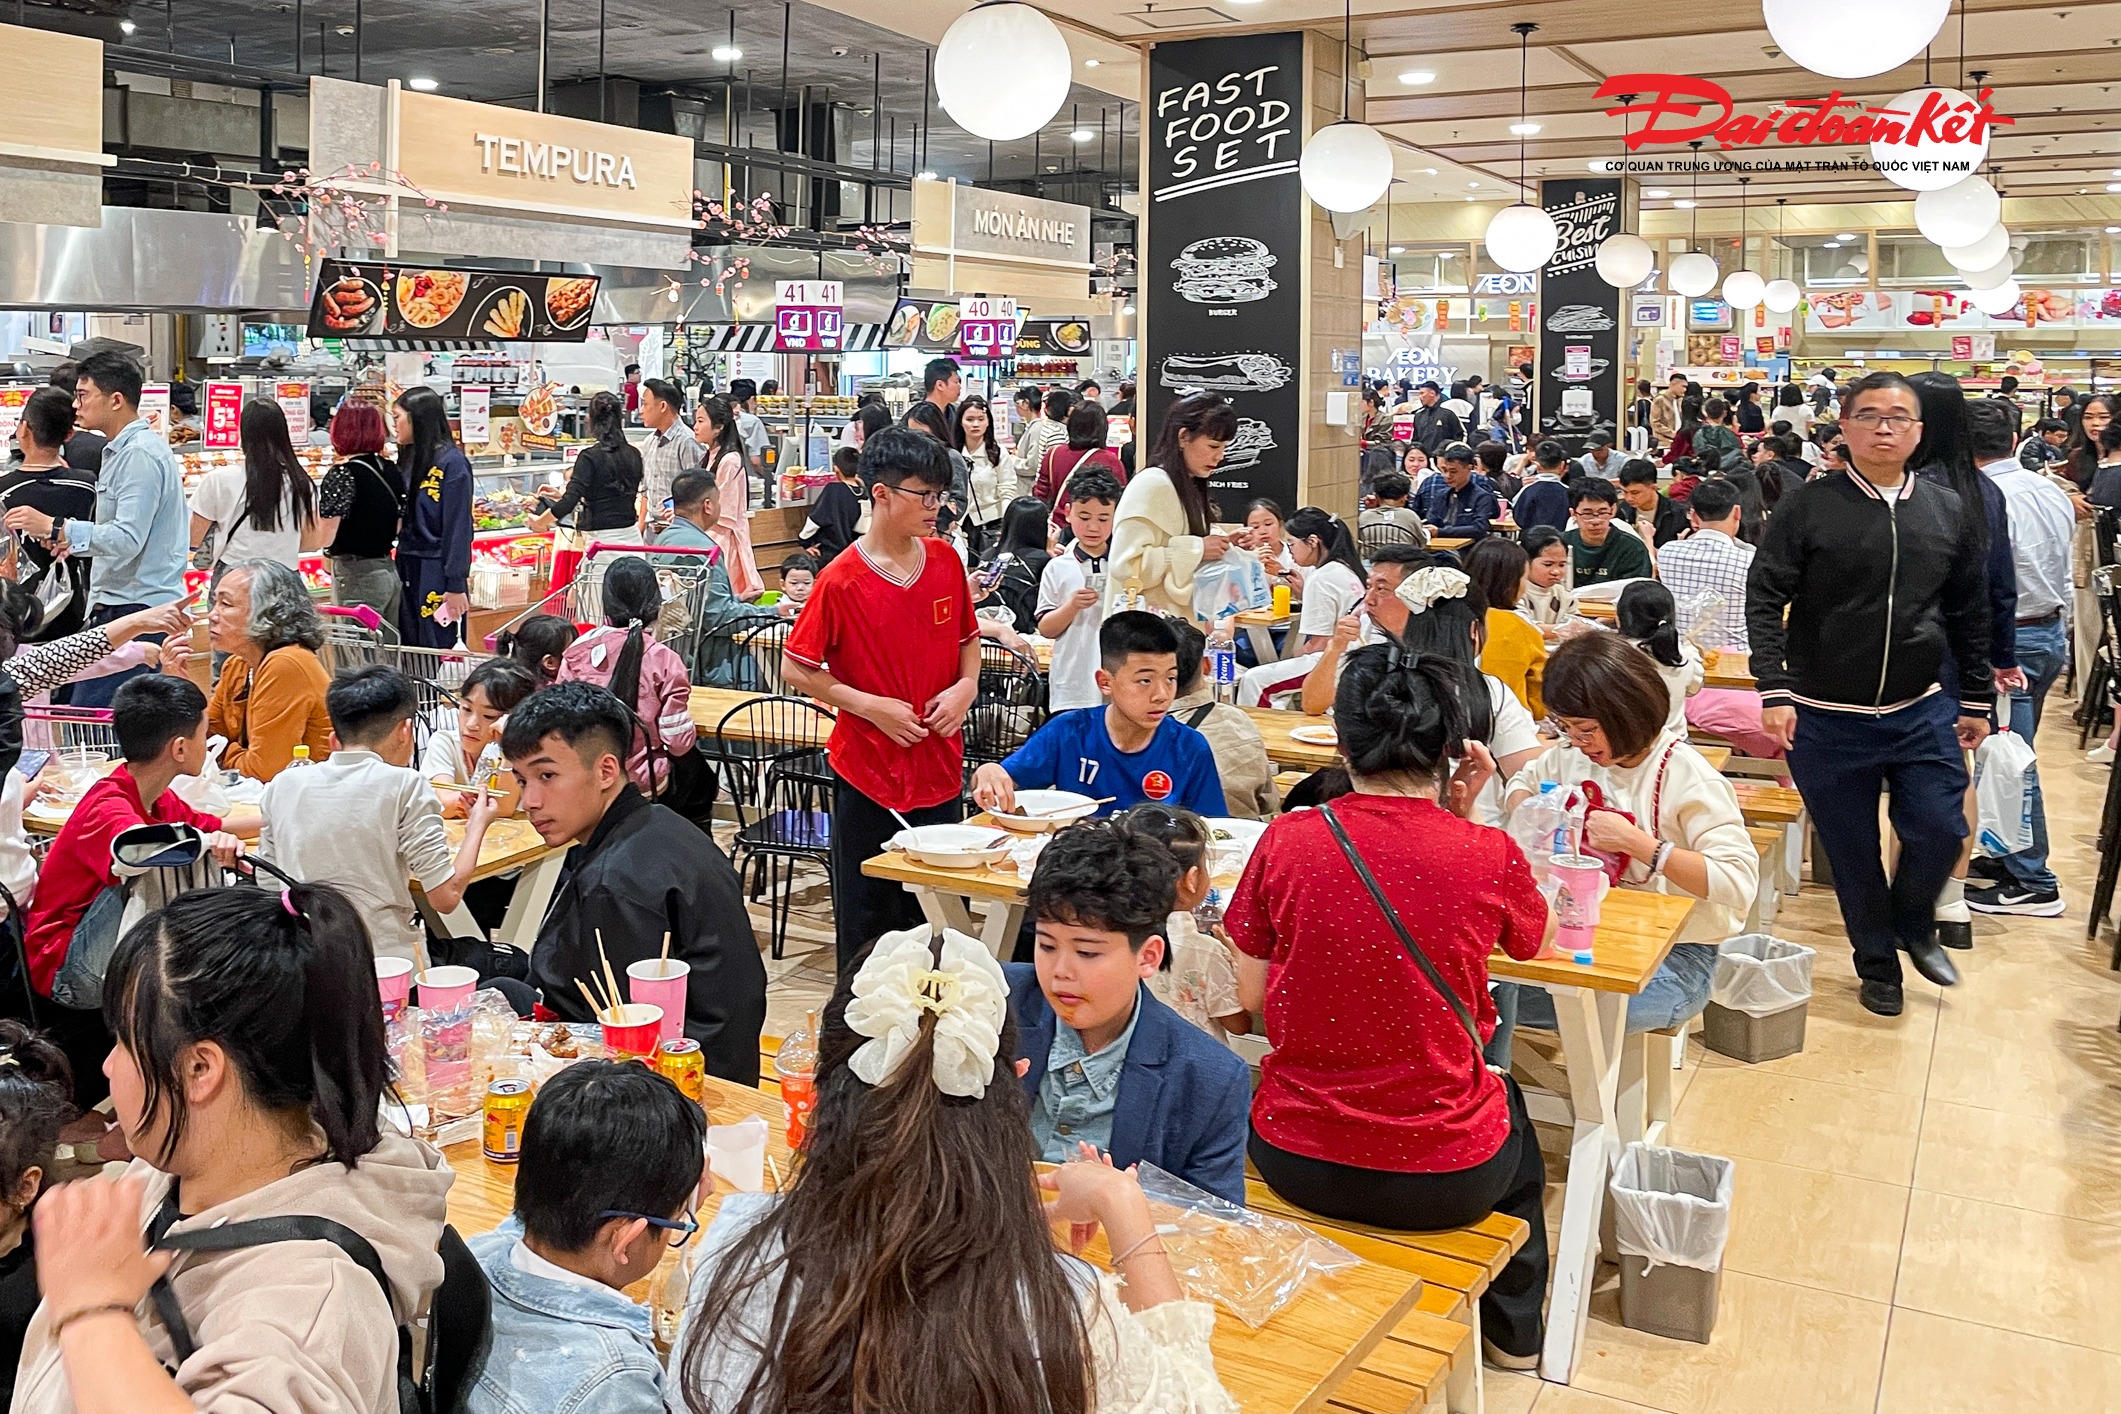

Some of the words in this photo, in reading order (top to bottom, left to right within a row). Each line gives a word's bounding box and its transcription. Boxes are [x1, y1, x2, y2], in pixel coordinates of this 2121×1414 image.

[1157, 66, 1279, 118] FAST
[1165, 100, 1291, 149] FOOD
[474, 132, 637, 189] TEMPURA
[1172, 129, 1291, 178] SET
[974, 205, 1013, 237] MÓN
[1042, 219, 1075, 249] NHẸ
[785, 284, 804, 302] 41
[821, 284, 835, 303] 41
[969, 301, 989, 316] 40
[1001, 301, 1012, 316] 40
[1078, 757, 1100, 785] 17
